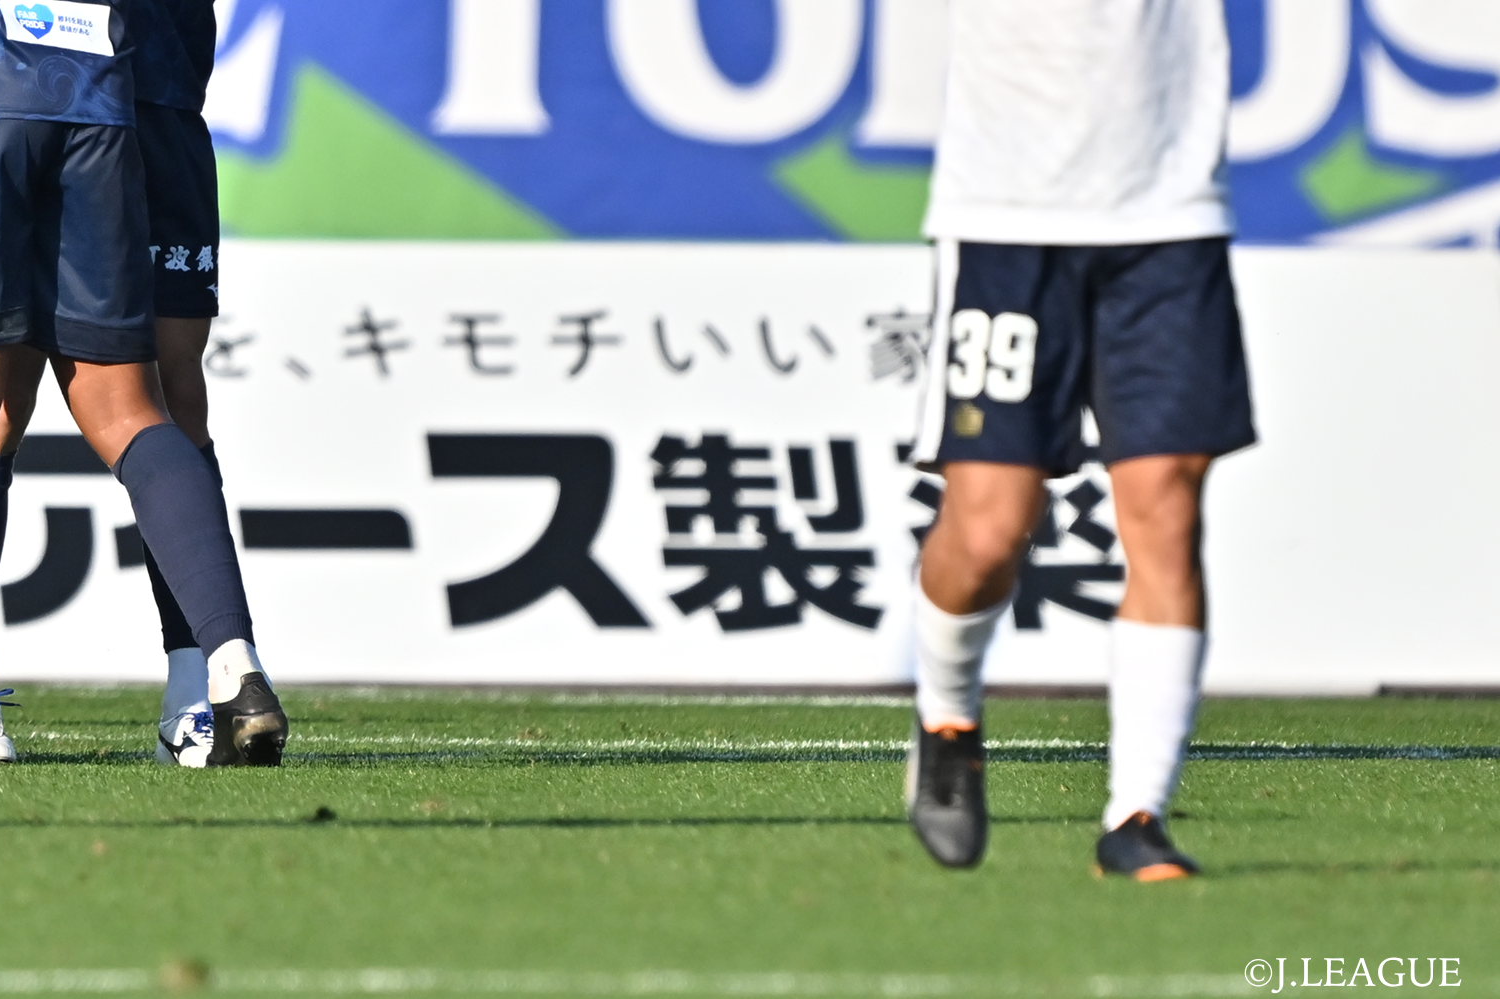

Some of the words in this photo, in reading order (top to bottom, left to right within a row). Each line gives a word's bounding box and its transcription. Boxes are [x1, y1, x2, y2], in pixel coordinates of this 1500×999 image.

[17, 10, 38, 20] FAIR
[19, 19, 47, 30] PRIDE
[57, 15, 93, 28] 勝利を超える
[59, 25, 90, 36] 価値がある
[947, 308, 1038, 402] 39
